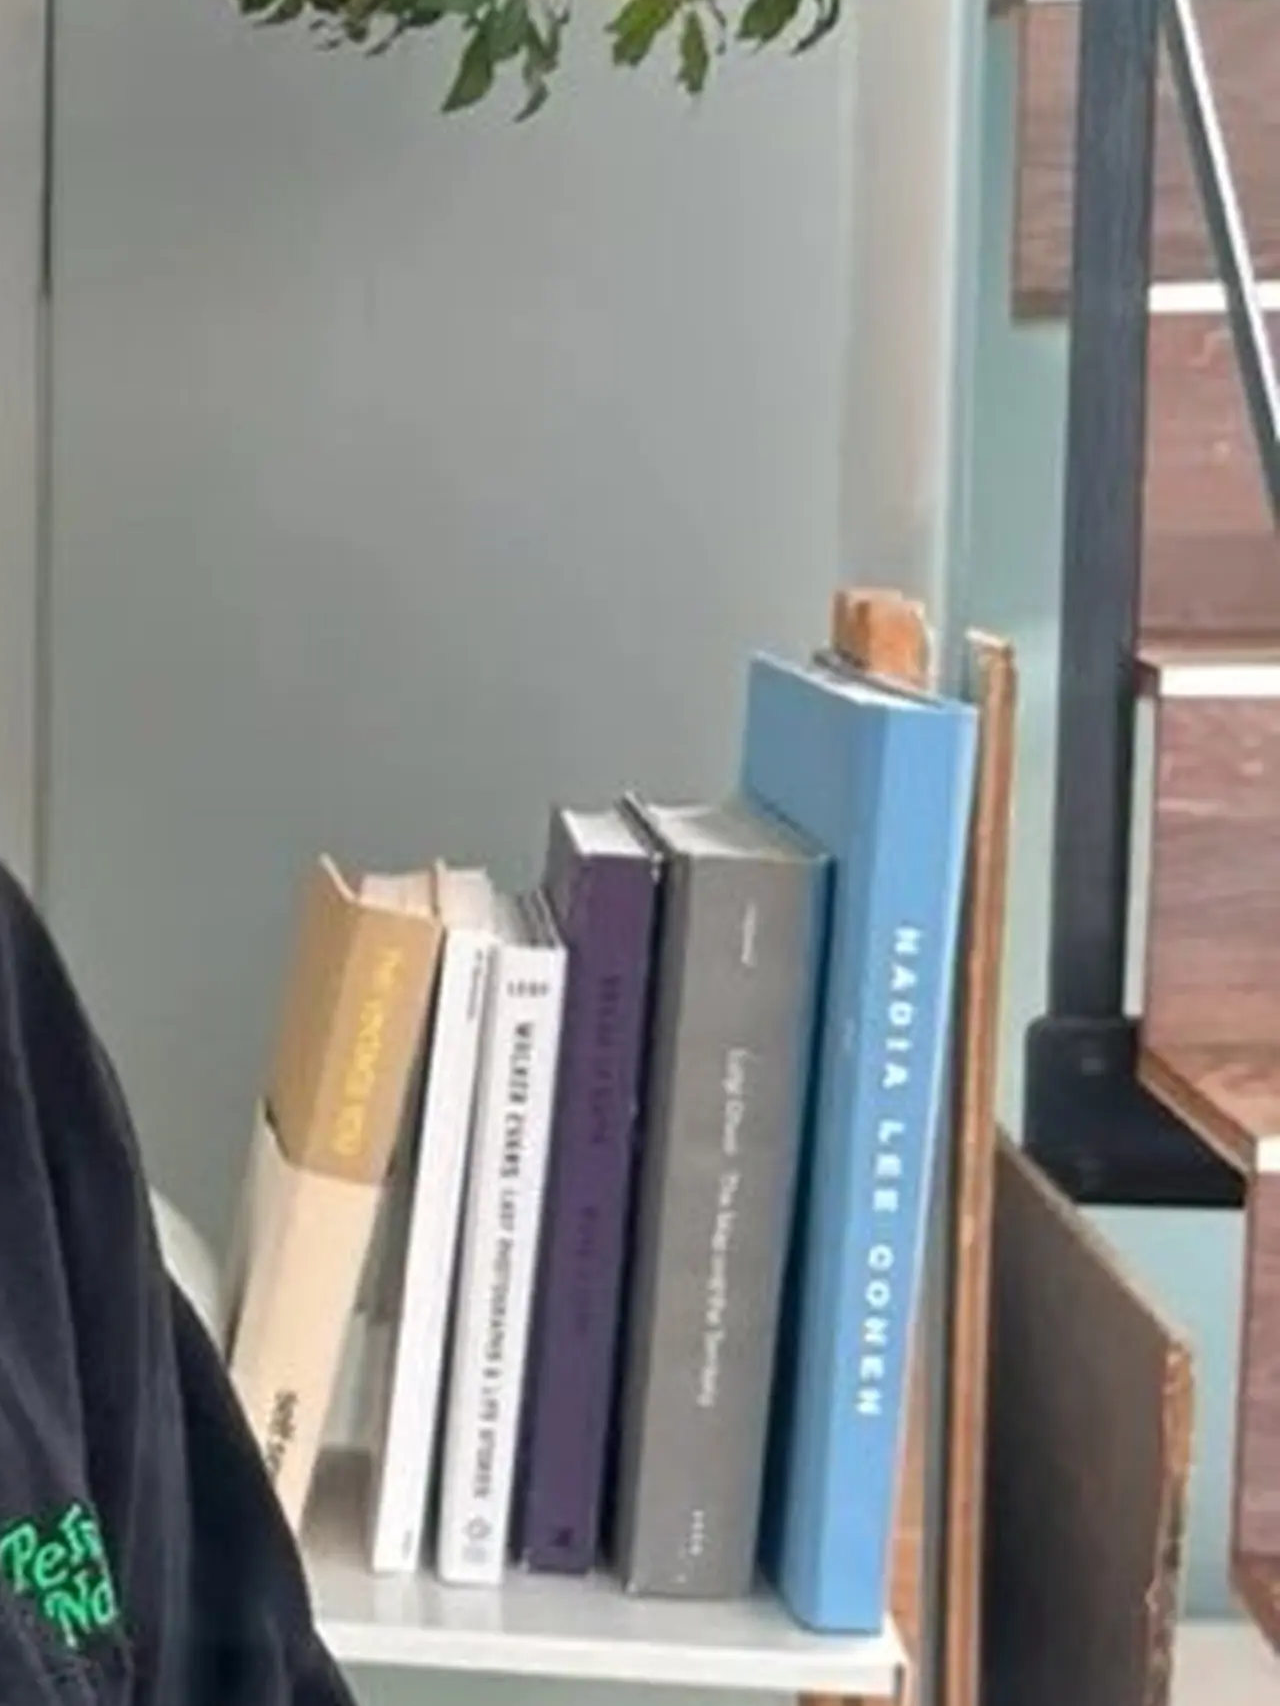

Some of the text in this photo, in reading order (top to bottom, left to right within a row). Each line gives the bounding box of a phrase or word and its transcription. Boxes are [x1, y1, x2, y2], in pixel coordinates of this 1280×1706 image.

[884, 926, 921, 1089] NADIA
[498, 1113, 527, 1177] EVANS
[873, 1120, 906, 1212] LEE
